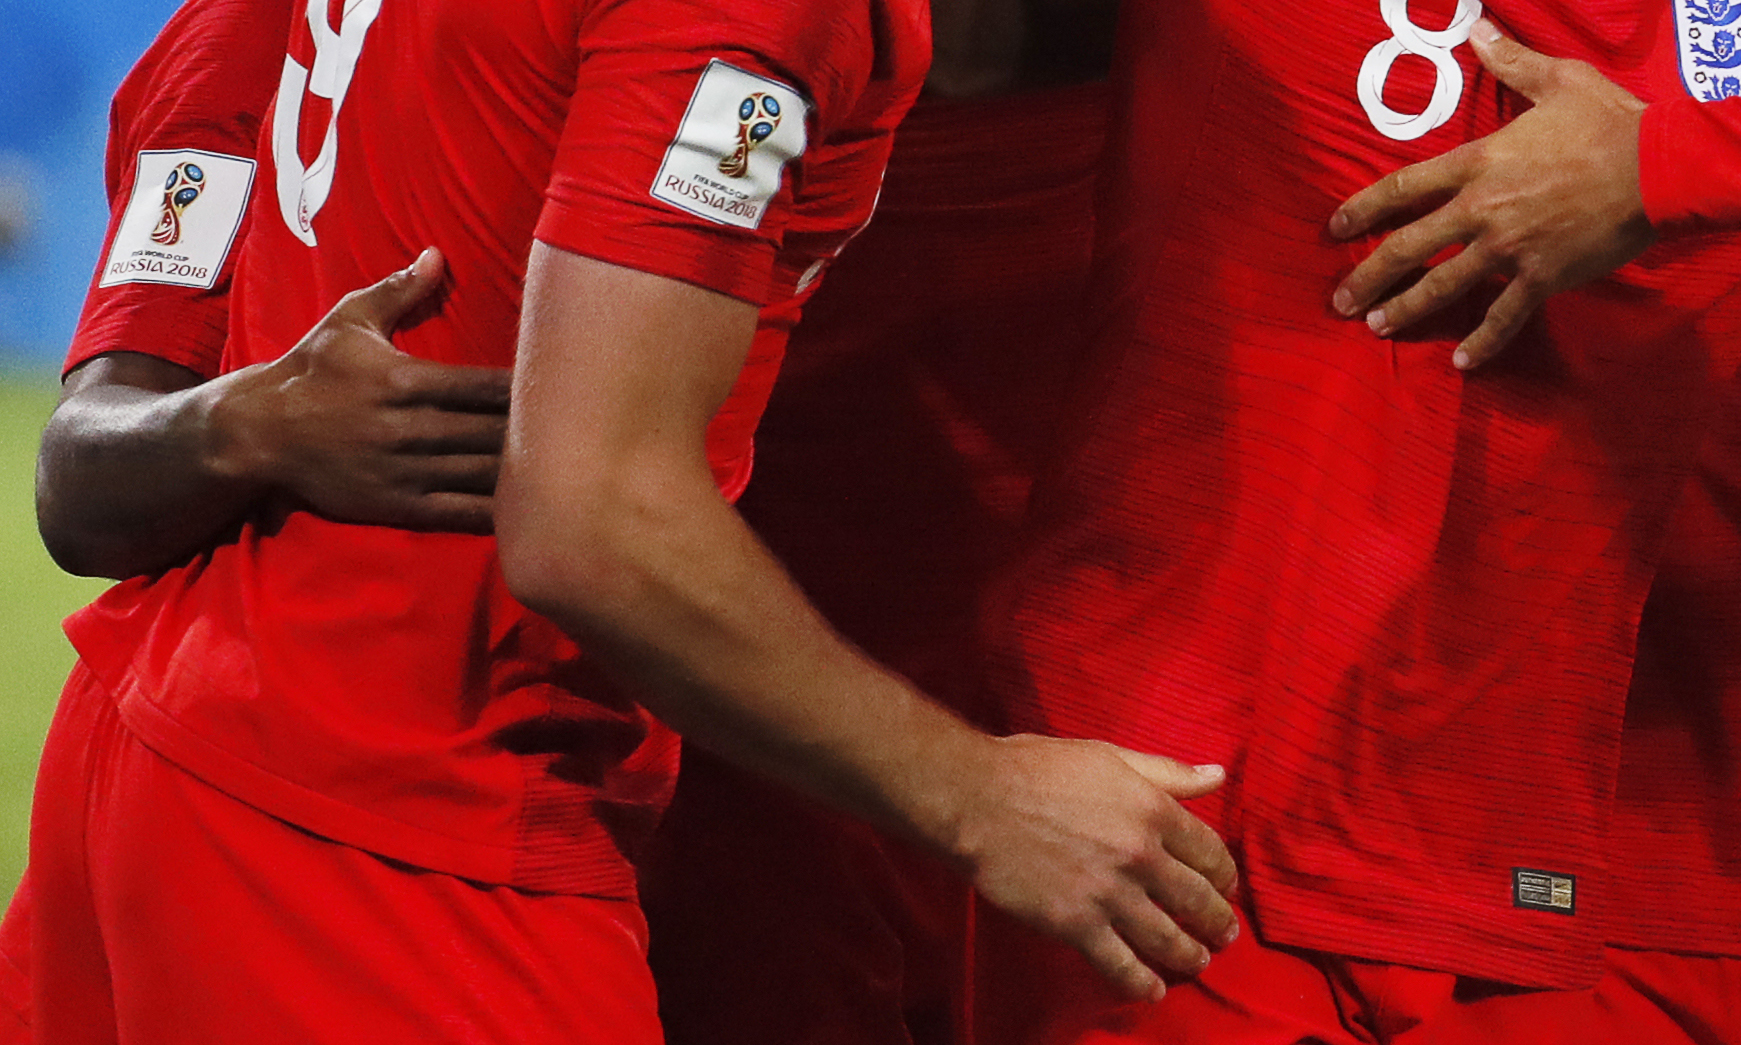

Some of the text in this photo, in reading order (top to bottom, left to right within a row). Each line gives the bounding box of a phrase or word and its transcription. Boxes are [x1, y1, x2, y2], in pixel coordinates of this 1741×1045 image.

[711, 180, 734, 195] WORLD
[666, 175, 757, 219] RUSSIA 2018
[145, 250, 173, 260] WORLD
[111, 258, 208, 278] RUSSIA 2018
